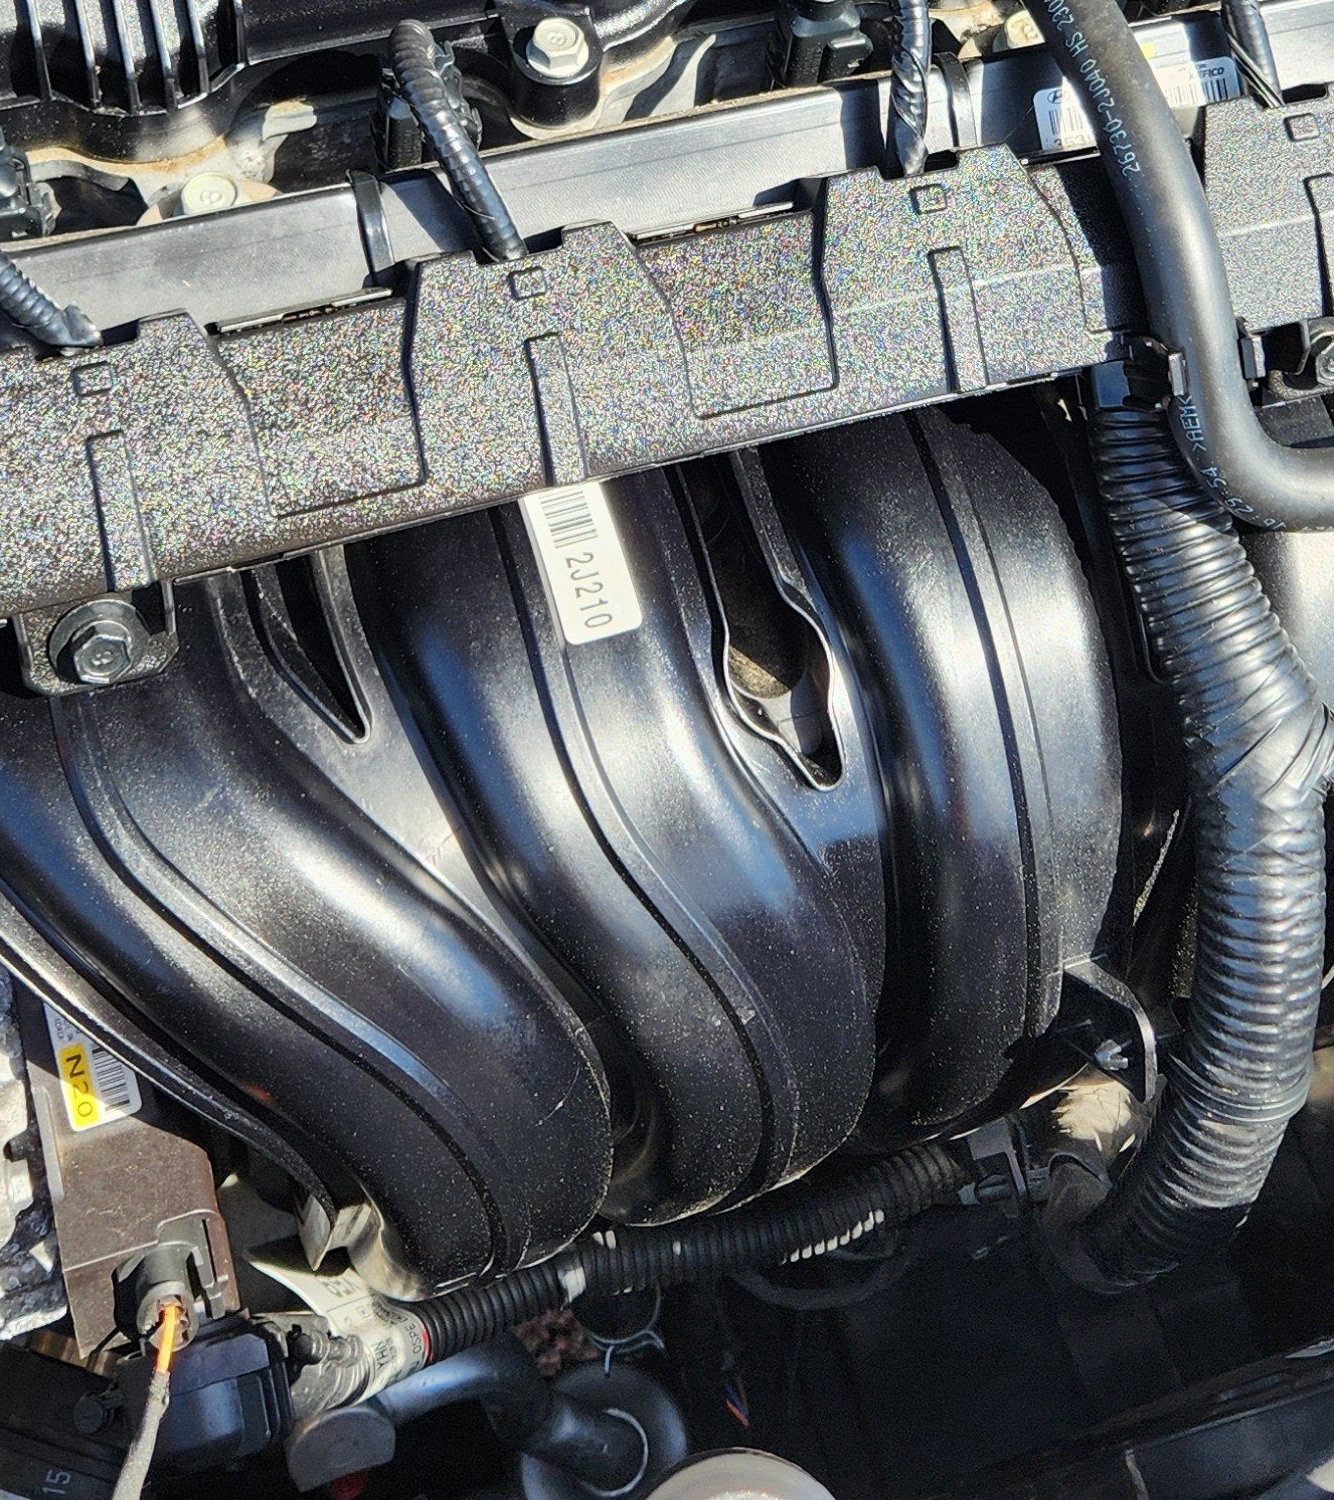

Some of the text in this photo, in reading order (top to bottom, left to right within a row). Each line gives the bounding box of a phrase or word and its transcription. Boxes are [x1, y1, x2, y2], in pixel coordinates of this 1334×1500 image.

[1065, 31, 1090, 59] HS
[1080, 58, 1142, 177] 26730-2J040
[566, 551, 613, 628] 2J210
